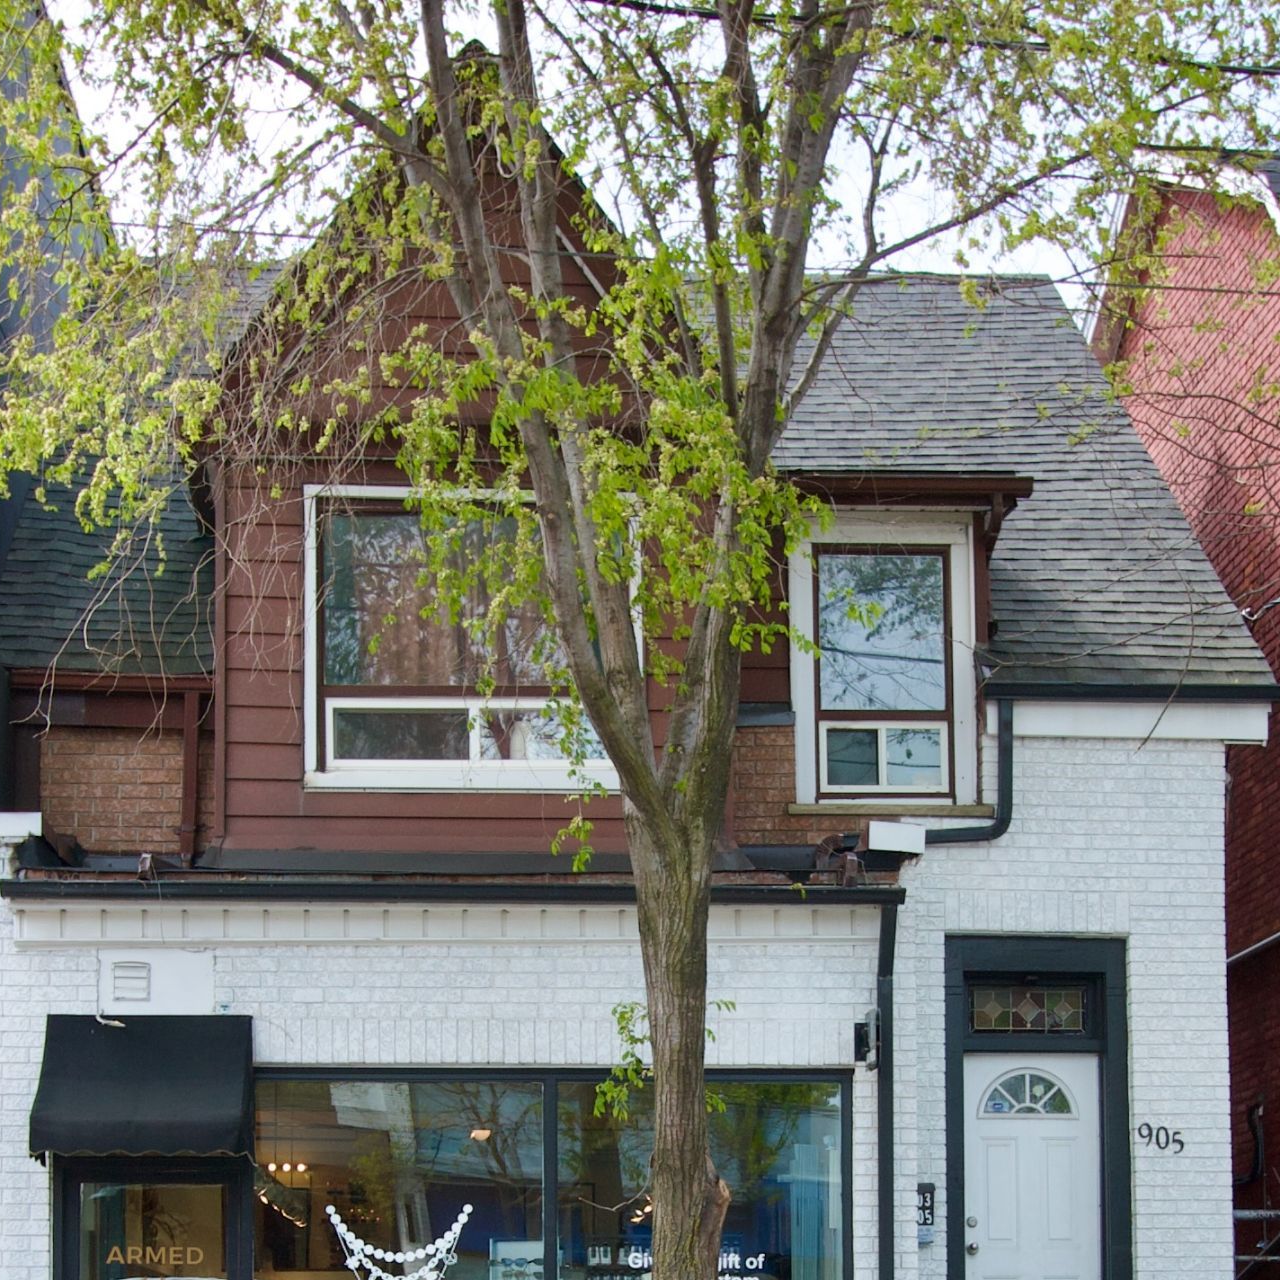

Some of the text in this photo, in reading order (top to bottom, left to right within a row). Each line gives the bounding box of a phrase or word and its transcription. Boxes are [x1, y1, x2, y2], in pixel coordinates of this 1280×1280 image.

[1137, 1122, 1185, 1154] 905
[106, 1246, 204, 1265] ARMED
[745, 1253, 766, 1269] of
